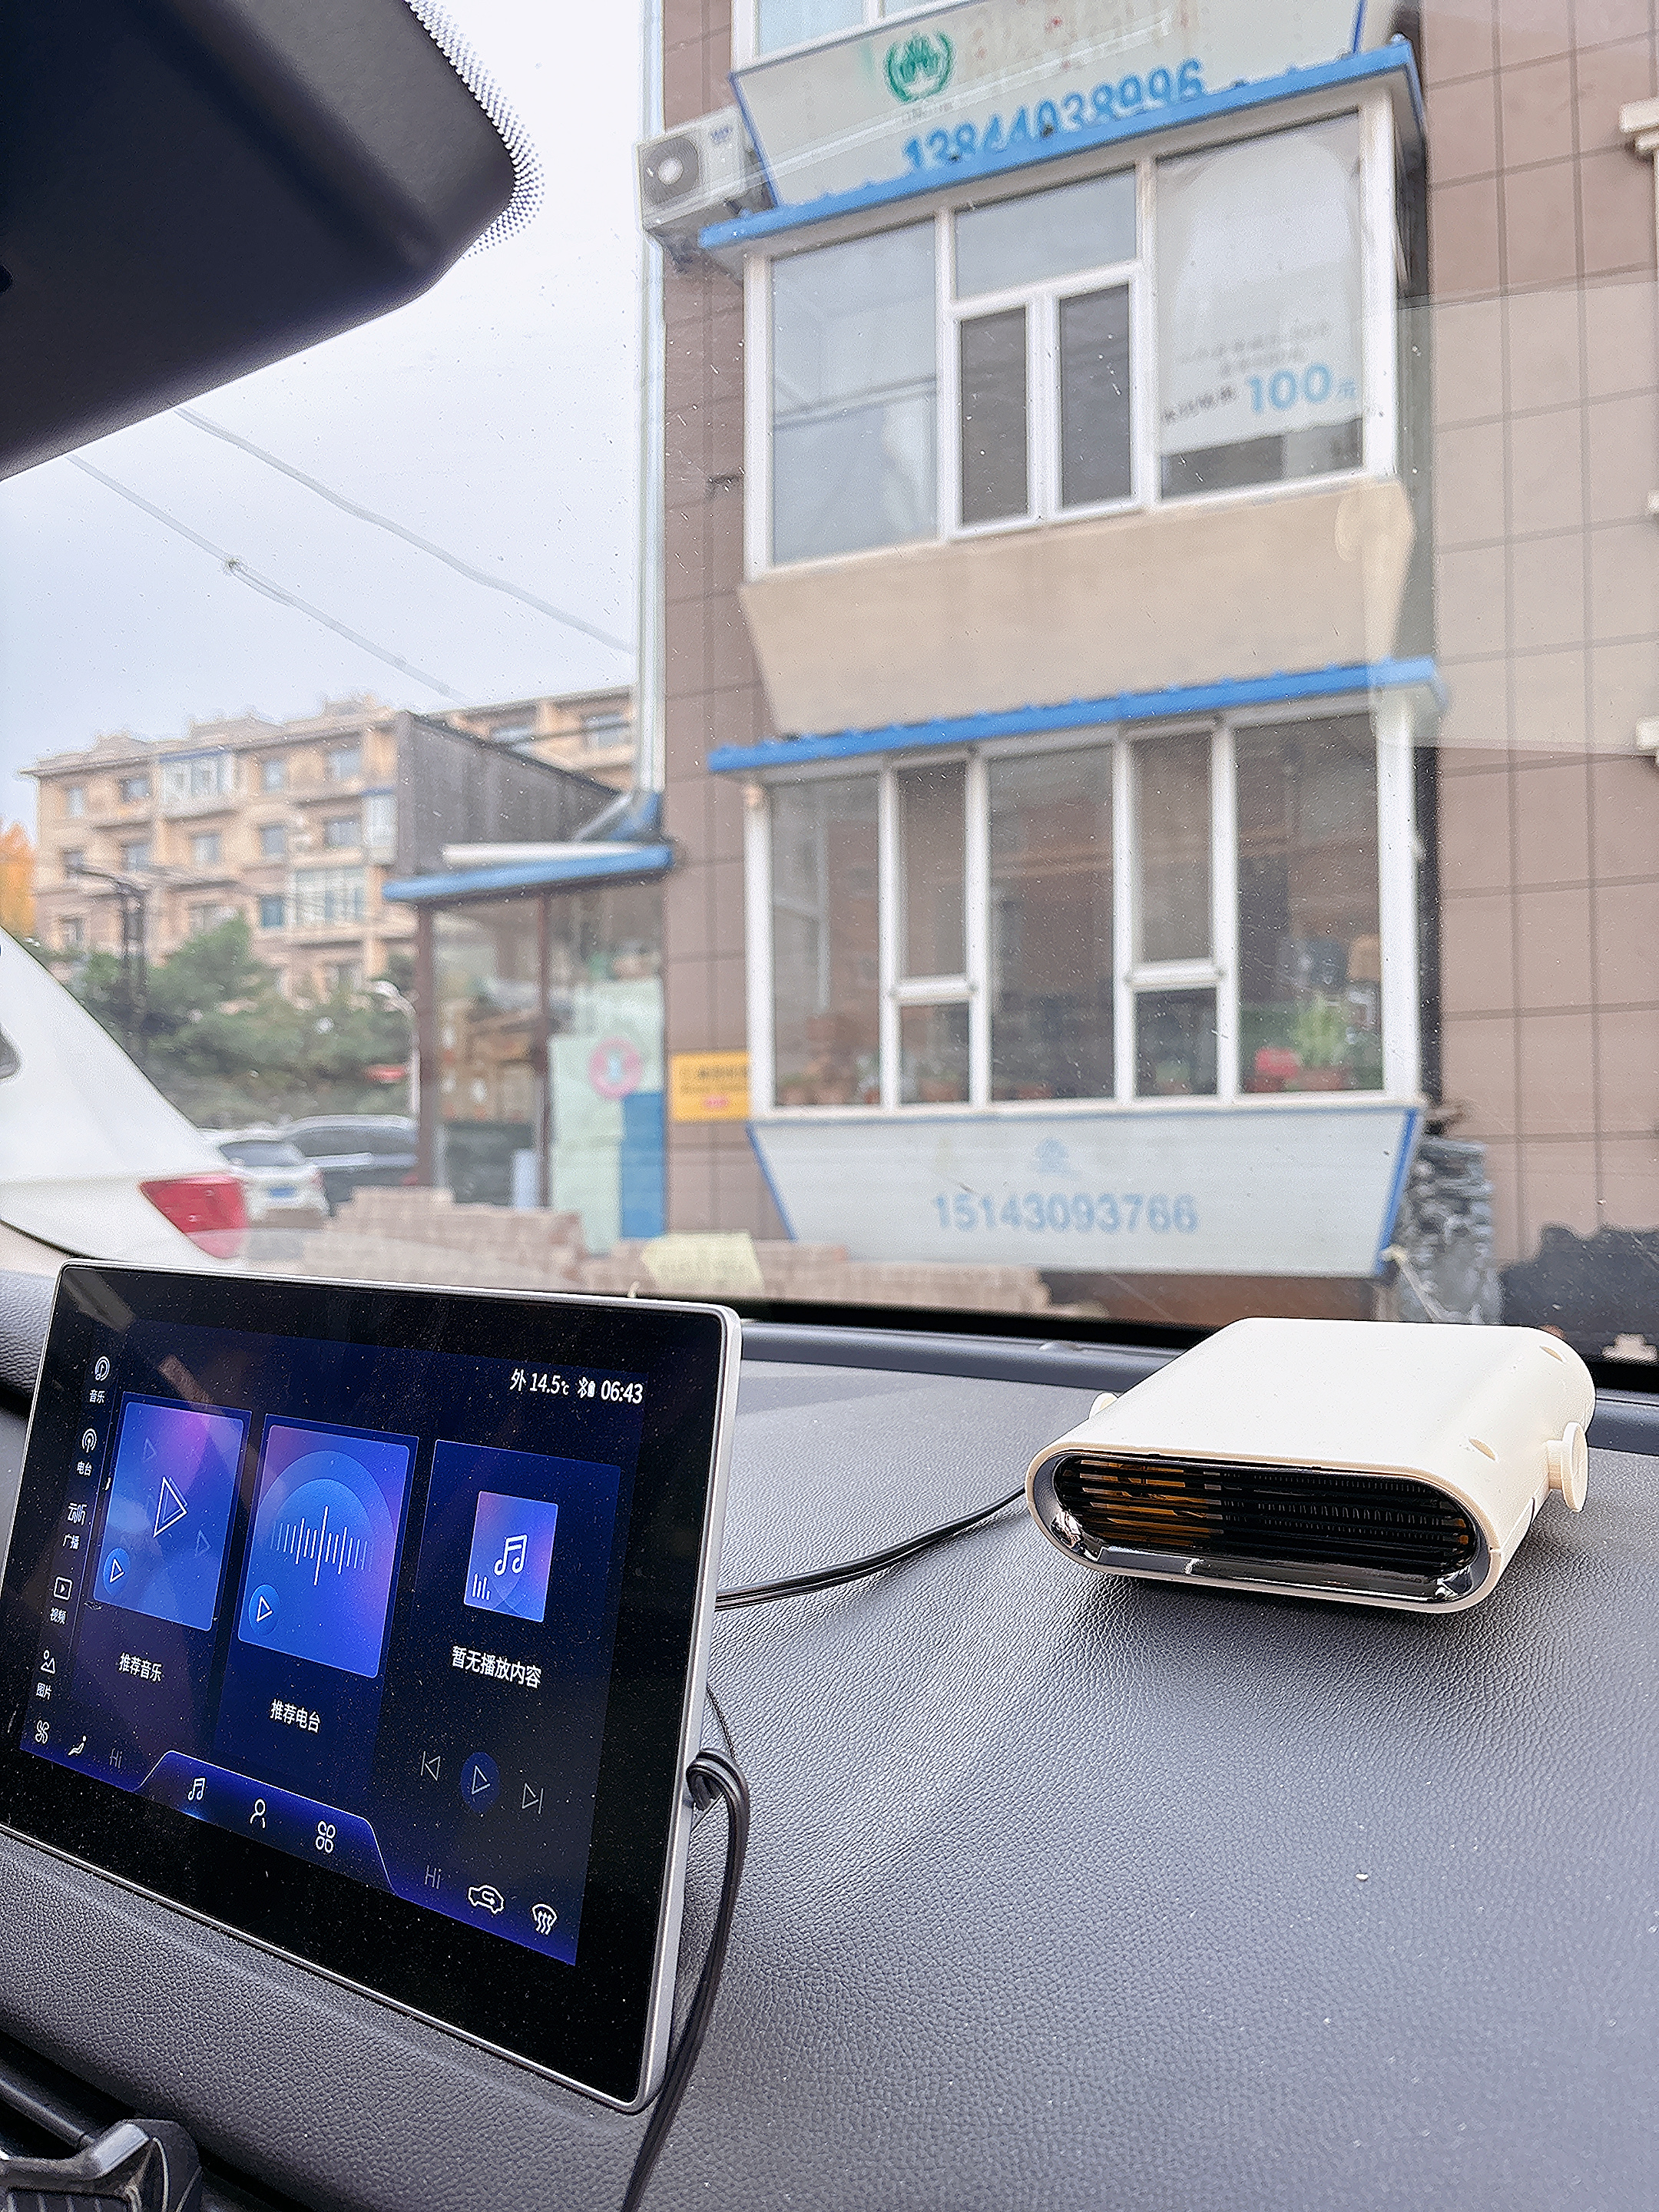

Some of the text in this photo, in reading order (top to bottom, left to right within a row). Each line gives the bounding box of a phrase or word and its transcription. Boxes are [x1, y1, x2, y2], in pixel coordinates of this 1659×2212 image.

[933, 1193, 1199, 1233] 15143093766
[89, 1389, 105, 1403] 音乐
[510, 1369, 527, 1391] 外
[601, 1380, 644, 1404] 06:43
[77, 1461, 92, 1476] 电台
[62, 1535, 80, 1550] 广播
[50, 1608, 67, 1624] 视频
[118, 1653, 163, 1682] 推荐音乐
[452, 1645, 541, 1689] 暂无播放内容
[36, 1682, 52, 1700] 图片
[270, 1699, 320, 1734] 推荐电台
[110, 1748, 122, 1768] Hi
[424, 1864, 442, 1889] Hi
